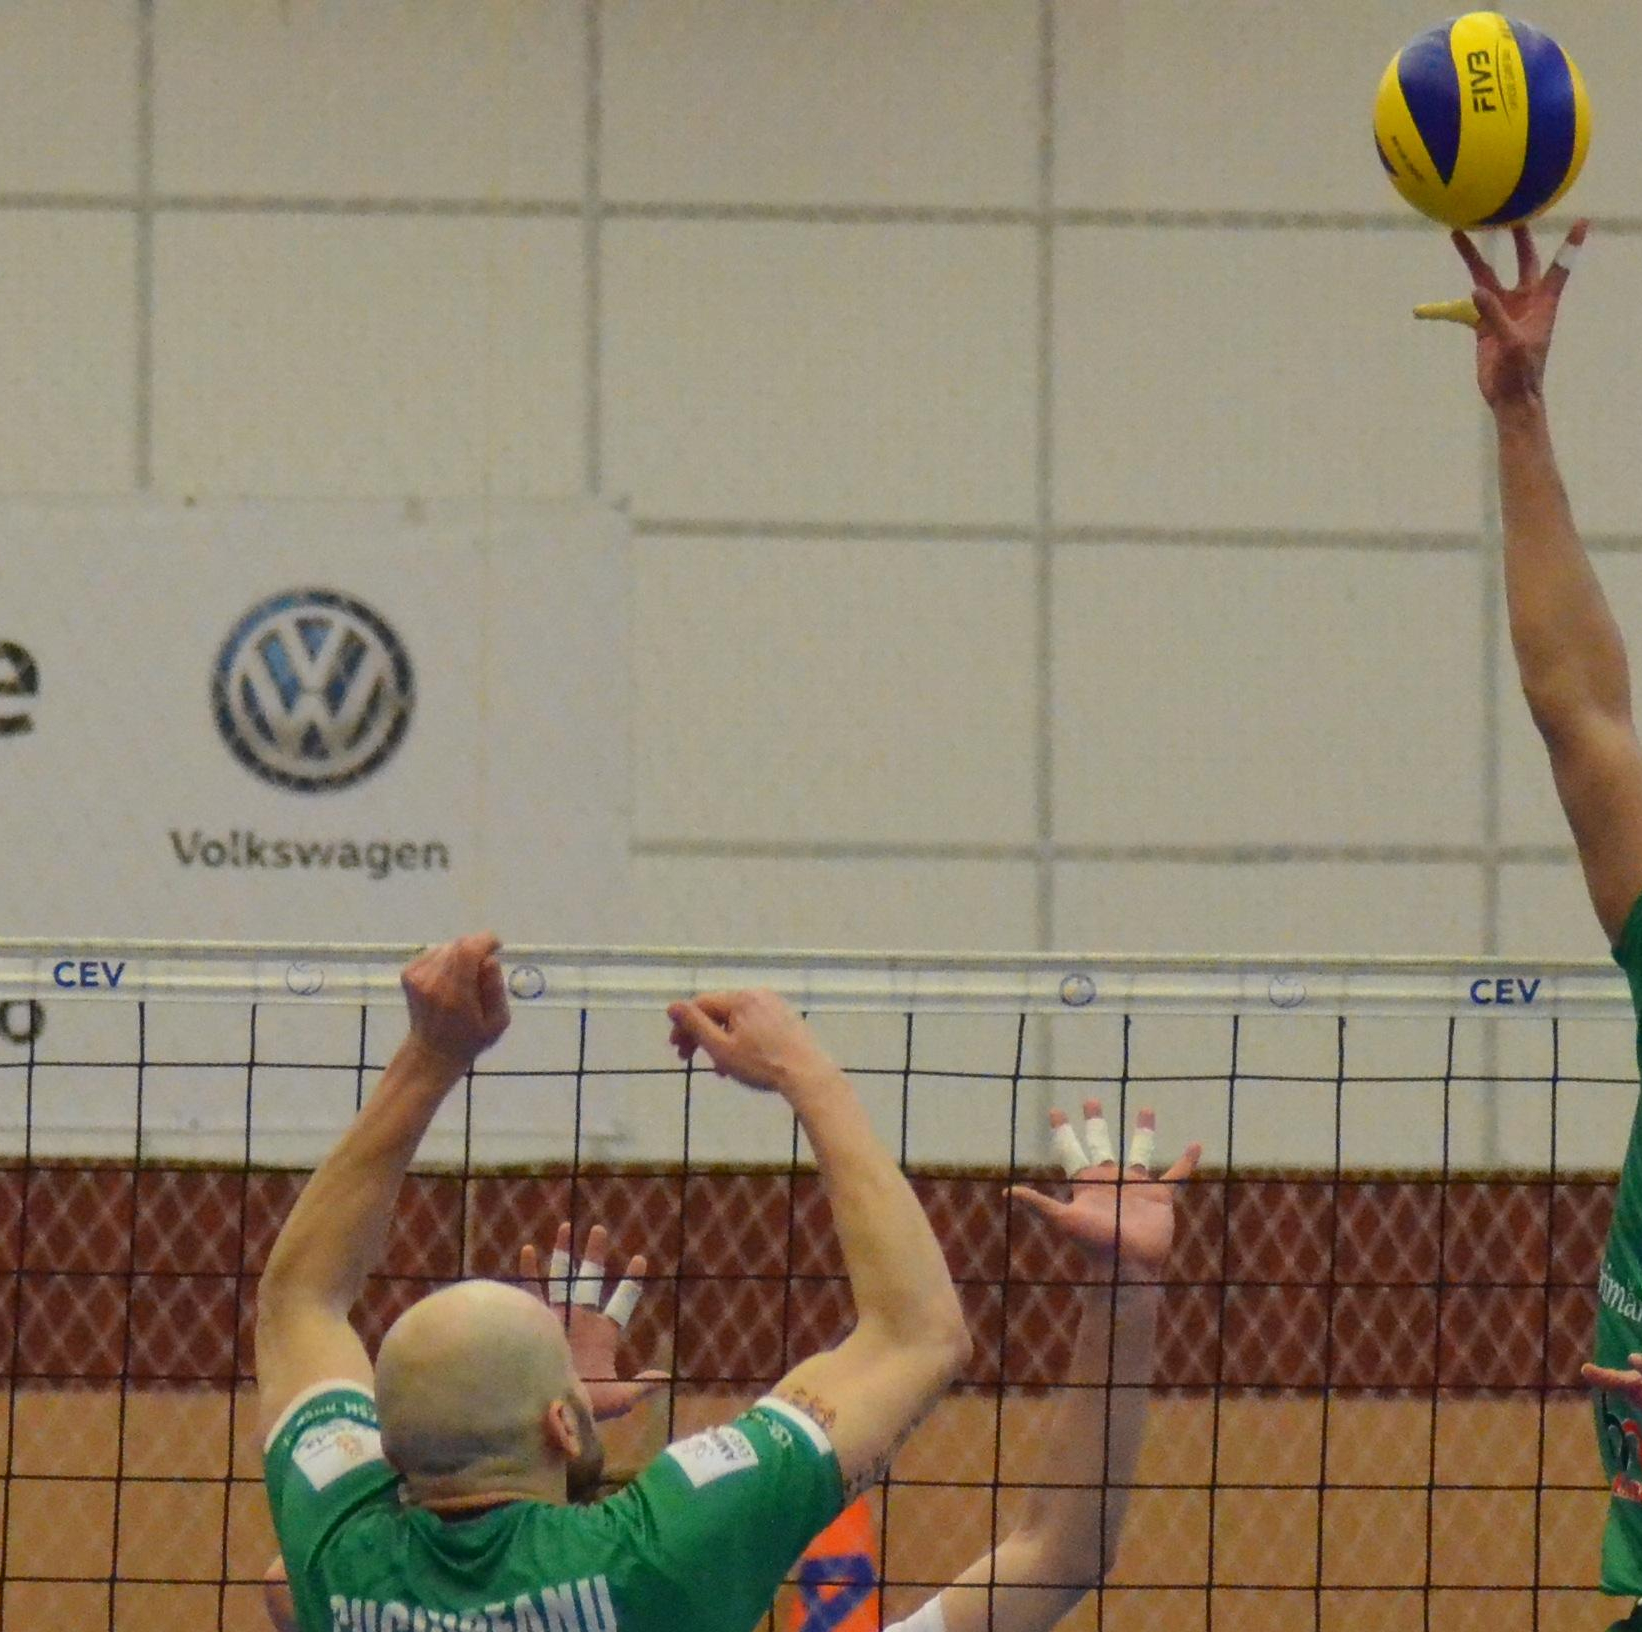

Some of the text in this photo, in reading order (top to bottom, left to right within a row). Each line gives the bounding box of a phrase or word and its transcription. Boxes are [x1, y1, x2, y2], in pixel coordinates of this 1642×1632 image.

[168, 830, 451, 880] Volkswagen
[53, 960, 126, 988] CEV
[1469, 977, 1541, 1005] CEV
